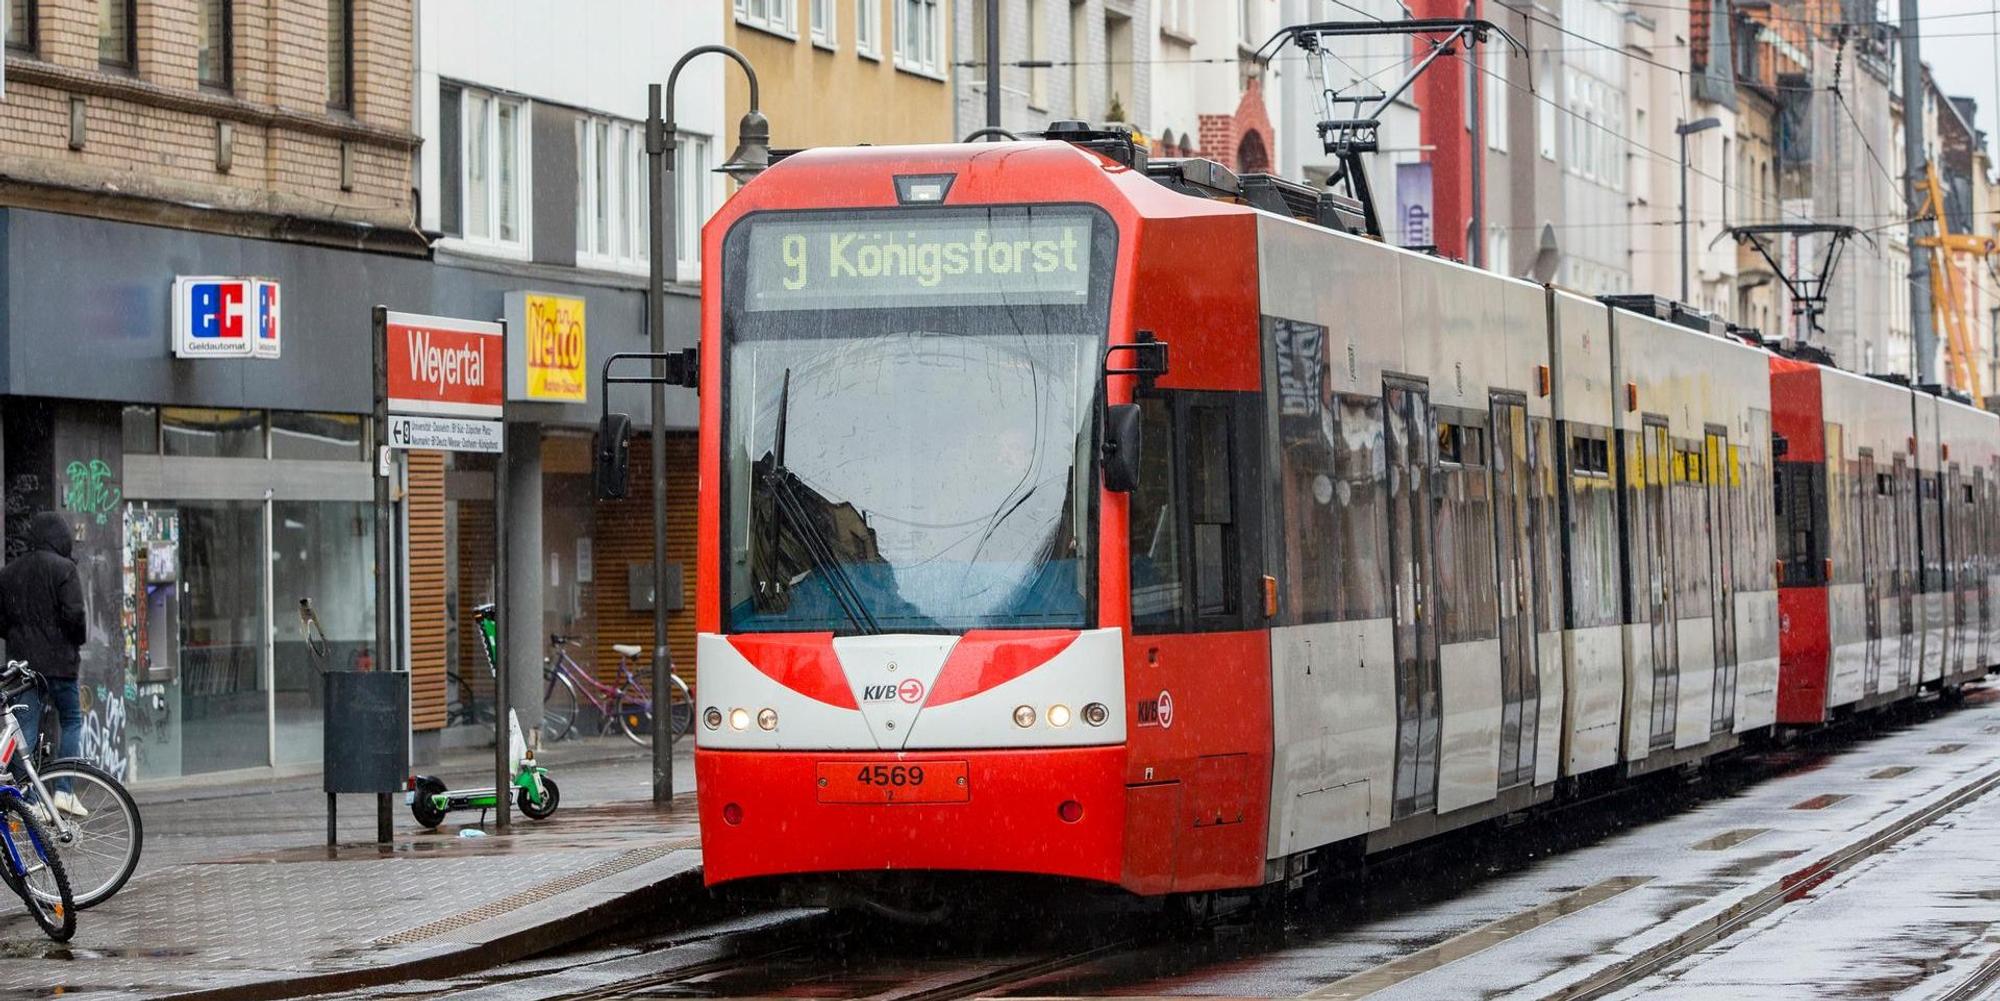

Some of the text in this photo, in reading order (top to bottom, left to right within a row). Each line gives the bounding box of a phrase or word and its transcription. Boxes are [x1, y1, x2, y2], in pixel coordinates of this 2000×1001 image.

[783, 226, 1078, 290] 9 Königsforst
[188, 342, 246, 351] Geldautomat
[529, 302, 583, 370] Netto
[407, 330, 485, 396] Weyertal
[863, 685, 897, 701] KVB
[1138, 700, 1158, 722] KVB
[857, 765, 924, 787] 4569
